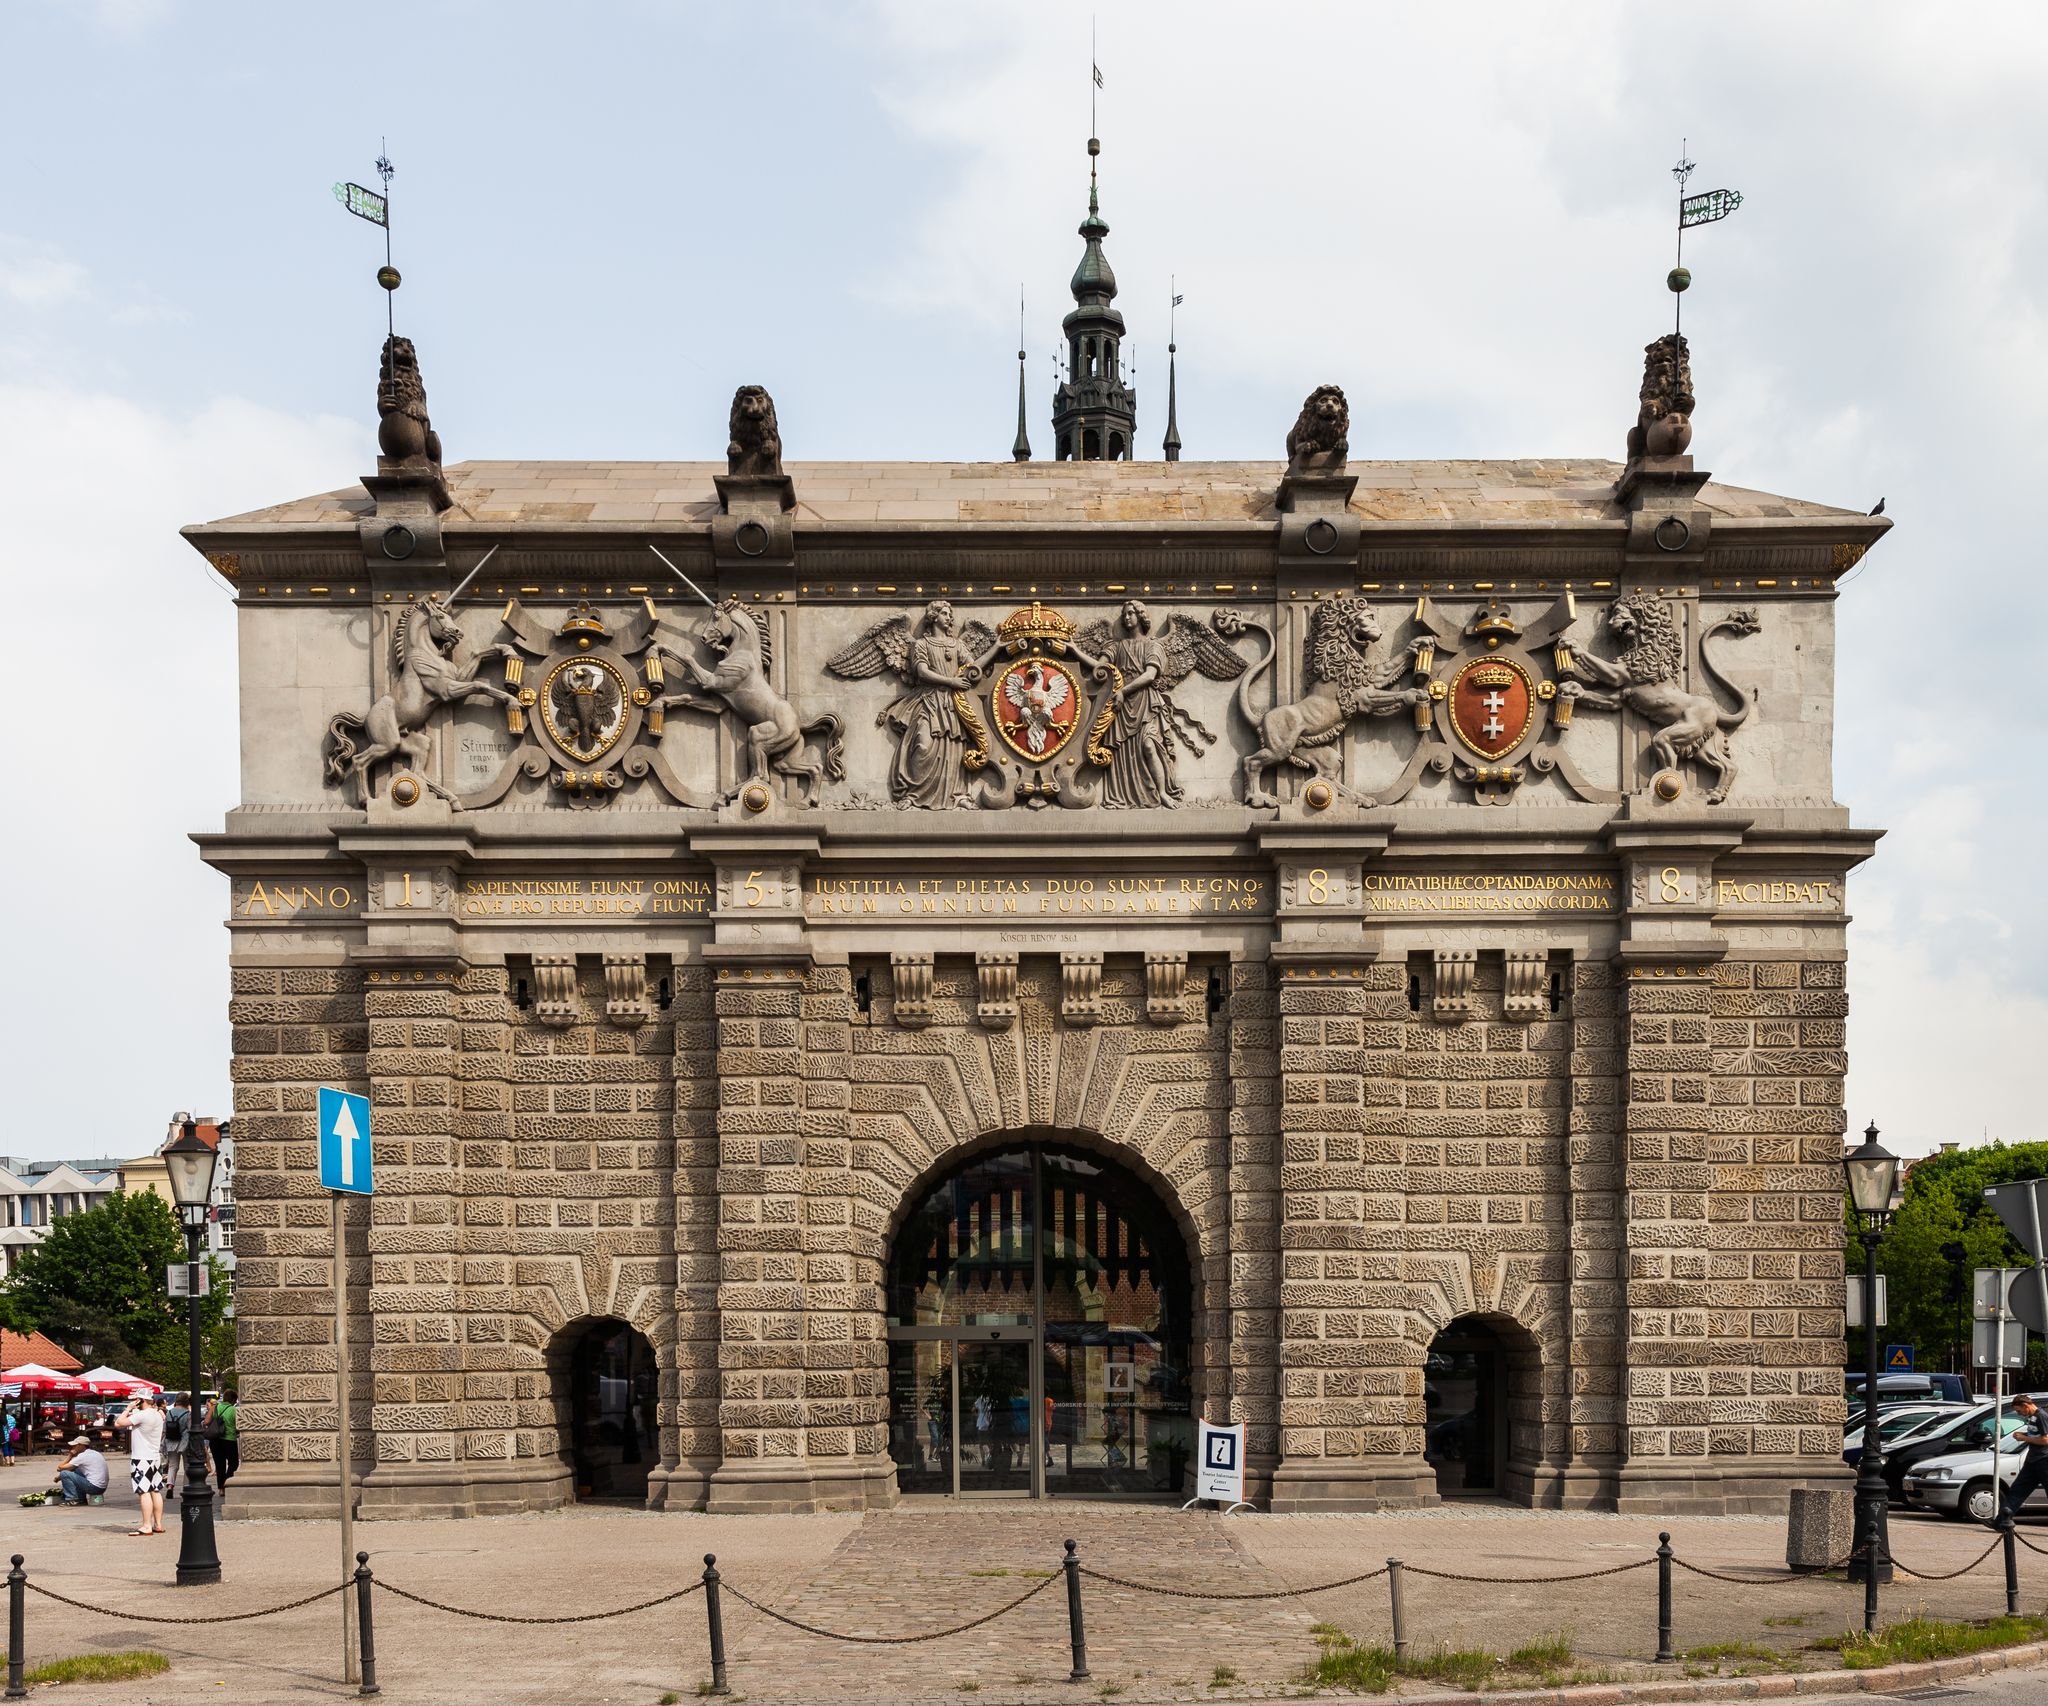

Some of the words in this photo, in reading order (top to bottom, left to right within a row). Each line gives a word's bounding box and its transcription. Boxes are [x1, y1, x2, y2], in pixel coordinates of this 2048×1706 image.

[467, 880, 583, 895] SAPIENTISSIME
[591, 881, 644, 895] FIUNT
[653, 881, 712, 895] OMNIA
[815, 878, 906, 895] IUSTITIA
[919, 880, 943, 895] ET
[956, 880, 1031, 895] PIETAS
[1047, 880, 1094, 894] DUO
[1107, 879, 1167, 894] SUNT
[1717, 879, 1831, 906] FACIEBAT
[511, 899, 544, 913] PRO
[550, 899, 644, 913] REPUBLICA
[653, 898, 711, 913] FIUNT.
[822, 898, 877, 912] RUM
[900, 898, 1017, 912] OMNIUM
[1040, 897, 1241, 912] FUNDAMENTA
